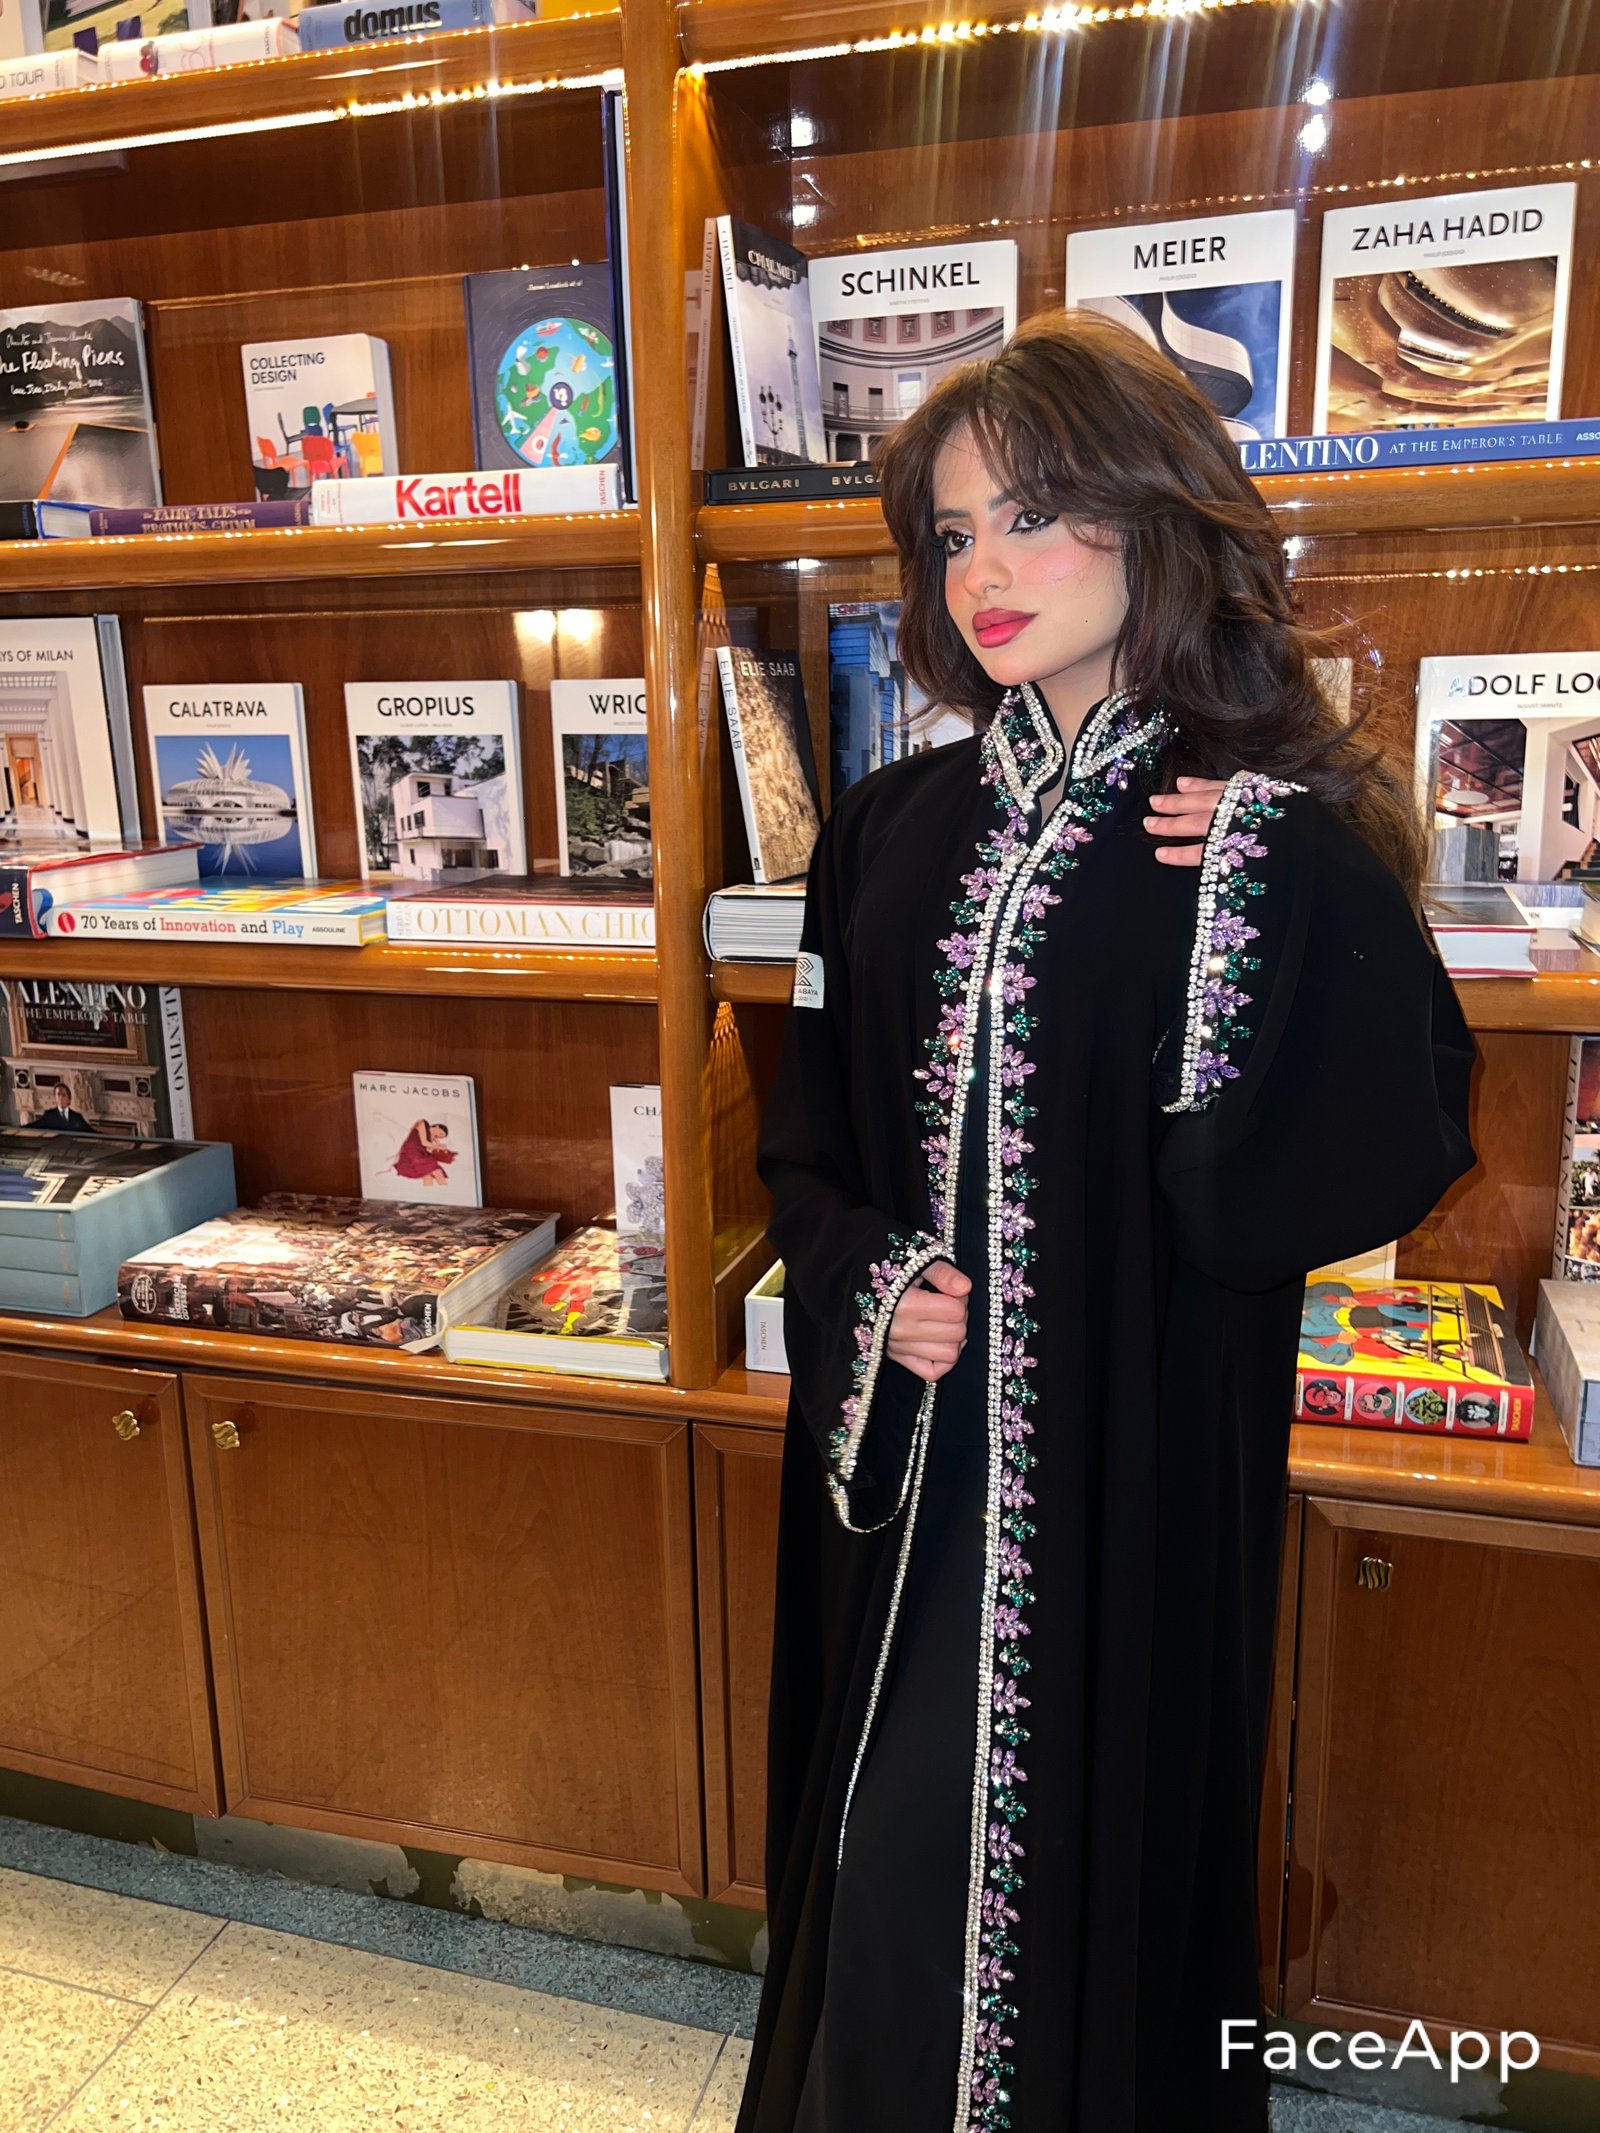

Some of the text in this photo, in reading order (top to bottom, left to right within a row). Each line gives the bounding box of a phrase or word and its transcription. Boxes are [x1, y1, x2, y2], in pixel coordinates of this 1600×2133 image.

[344, 1, 441, 42] domus
[9, 69, 45, 87] TOUR
[1352, 209, 1543, 251] ZAHA HADID
[1133, 236, 1226, 269] MEIER
[841, 262, 980, 297] SCHINKEL
[22, 346, 82, 380] Floating
[250, 352, 325, 370] COLLECTING
[251, 369, 297, 384] DESIGN
[1240, 436, 1379, 470] LENTINO
[1389, 443, 1406, 454] AT
[1411, 441, 1438, 452] THE
[1442, 435, 1516, 451] EMPEROR'S
[1520, 433, 1563, 445] TABLE
[395, 473, 522, 518] Kartell
[599, 469, 607, 506] TASCHEN
[728, 478, 800, 491] BVLGARI
[153, 508, 192, 521] FAIRY
[196, 506, 237, 519] TALES
[16, 650, 32, 662] OF
[36, 649, 74, 661] MILAN
[740, 661, 796, 677] ELIE SAAB
[1448, 672, 1600, 697] ADOLF LO
[169, 701, 268, 718] CALATRAVA
[377, 696, 475, 717] GROPIUS
[720, 660, 742, 750] ELIE SAAB
[12, 883, 23, 924] TASCHEN
[81, 915, 98, 929] 70
[101, 916, 139, 930] Years
[143, 917, 157, 931] of
[160, 917, 236, 933] Innovation
[240, 920, 268, 934] and
[272, 919, 304, 937] Play
[416, 907, 575, 937] OTTOMAN
[113, 1012, 149, 1025] TABLE
[359, 1083, 460, 1098] MARC JACOBS
[1559, 1057, 1577, 1193] ITALIAN
[424, 1303, 433, 1337] TASCHEN
[1511, 1398, 1522, 1431] TASCHEN
